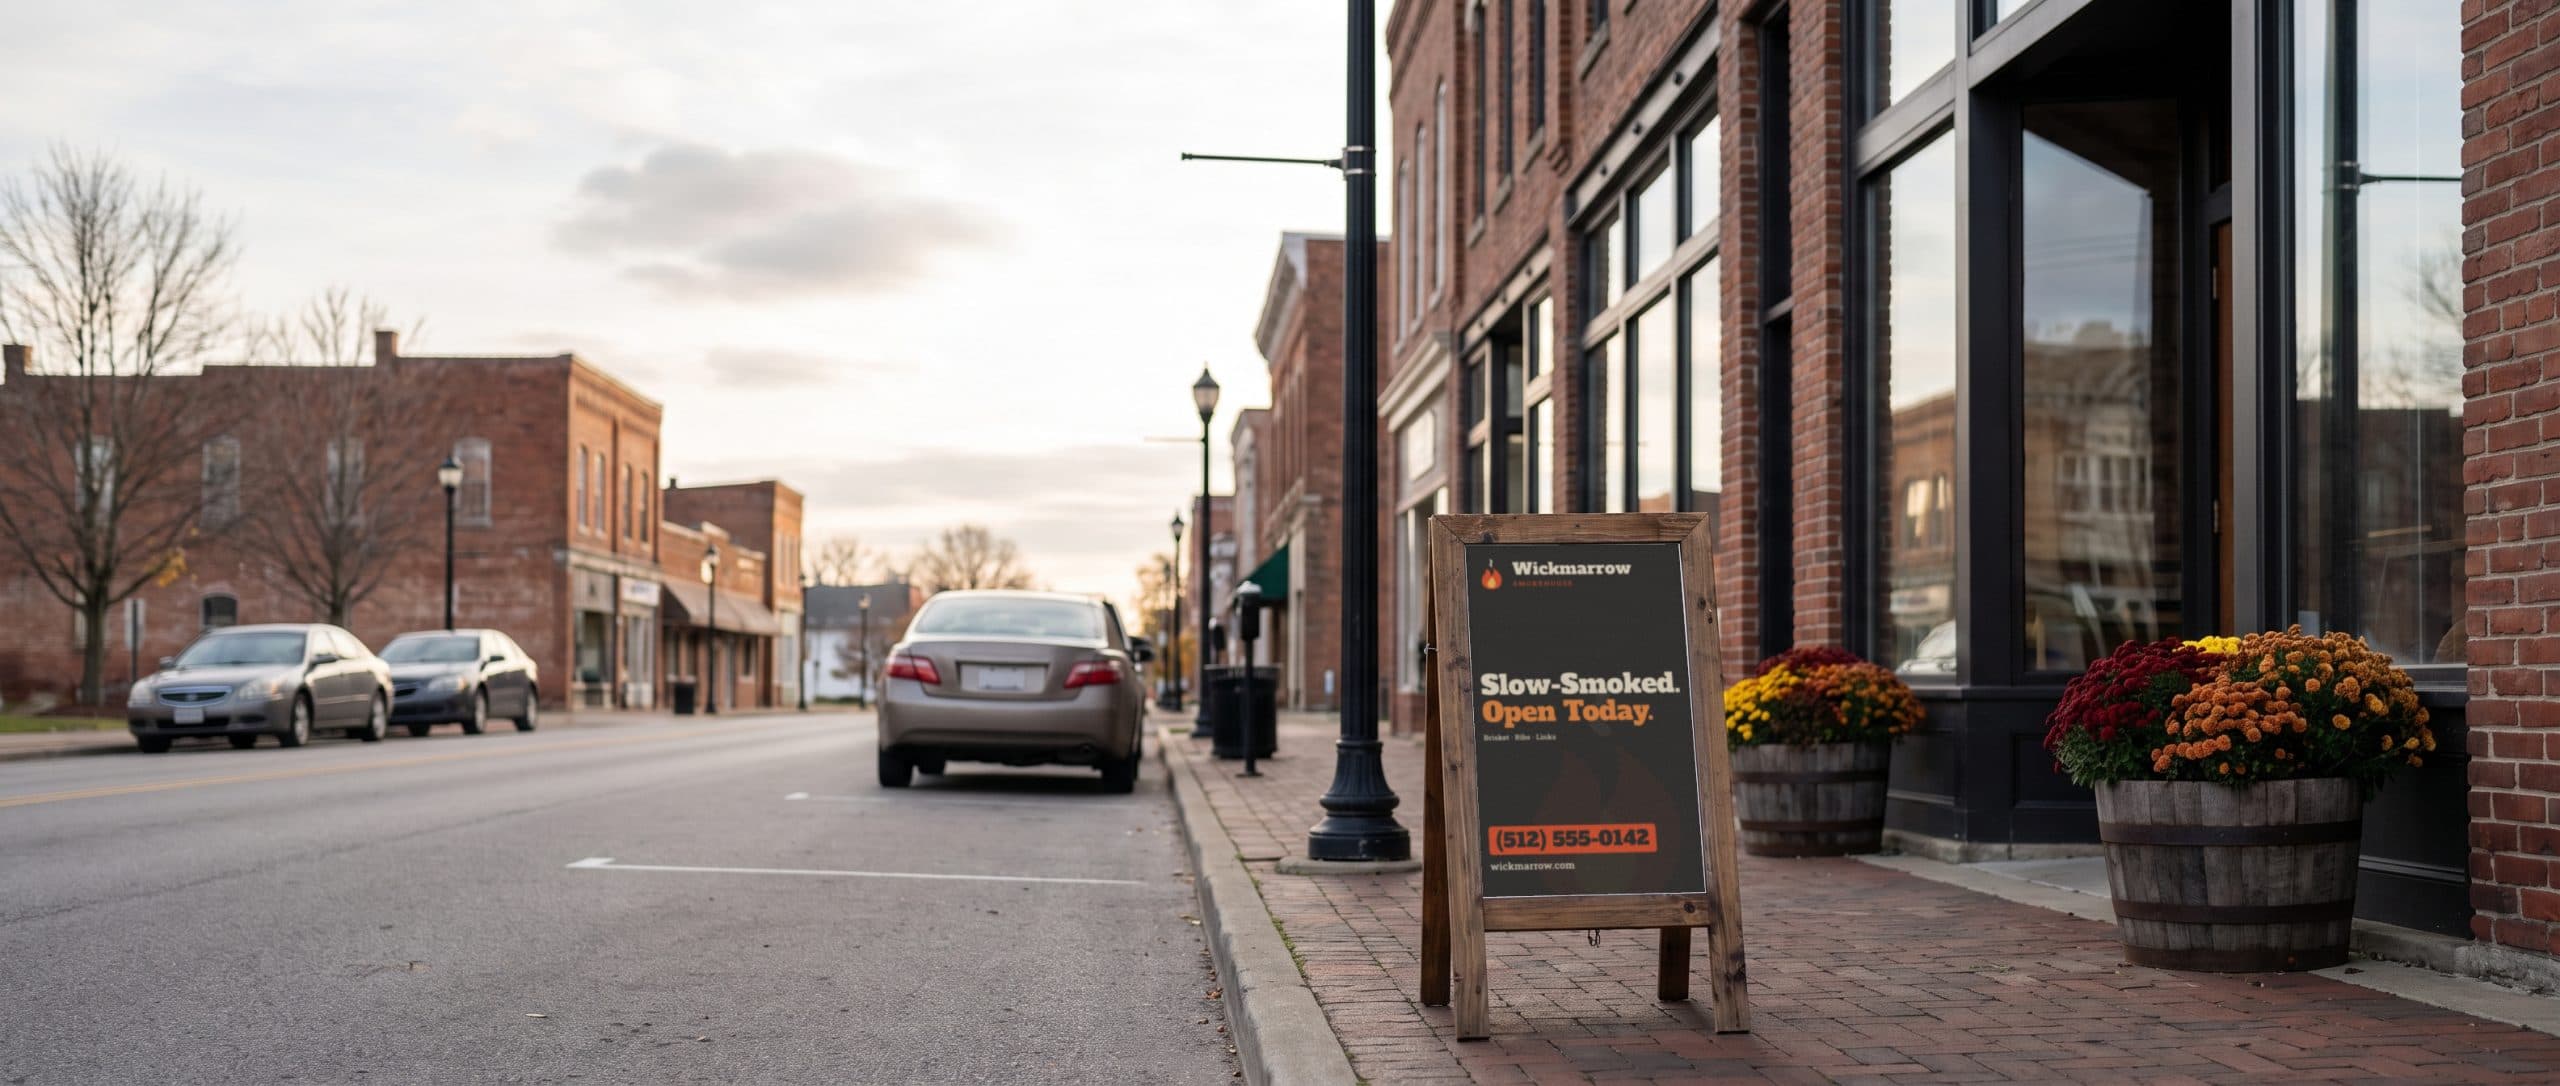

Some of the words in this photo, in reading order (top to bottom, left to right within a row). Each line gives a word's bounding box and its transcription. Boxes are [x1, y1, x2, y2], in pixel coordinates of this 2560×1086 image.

[1512, 561, 1632, 576] Wickmarrow
[1480, 671, 1681, 696] Slow-Smoked.
[1482, 700, 1557, 729] Open
[1562, 698, 1654, 727] Today.
[1496, 829, 1547, 851] (512)
[1552, 829, 1650, 848] 555-0142
[1490, 861, 1575, 871] wickmarrow.com
